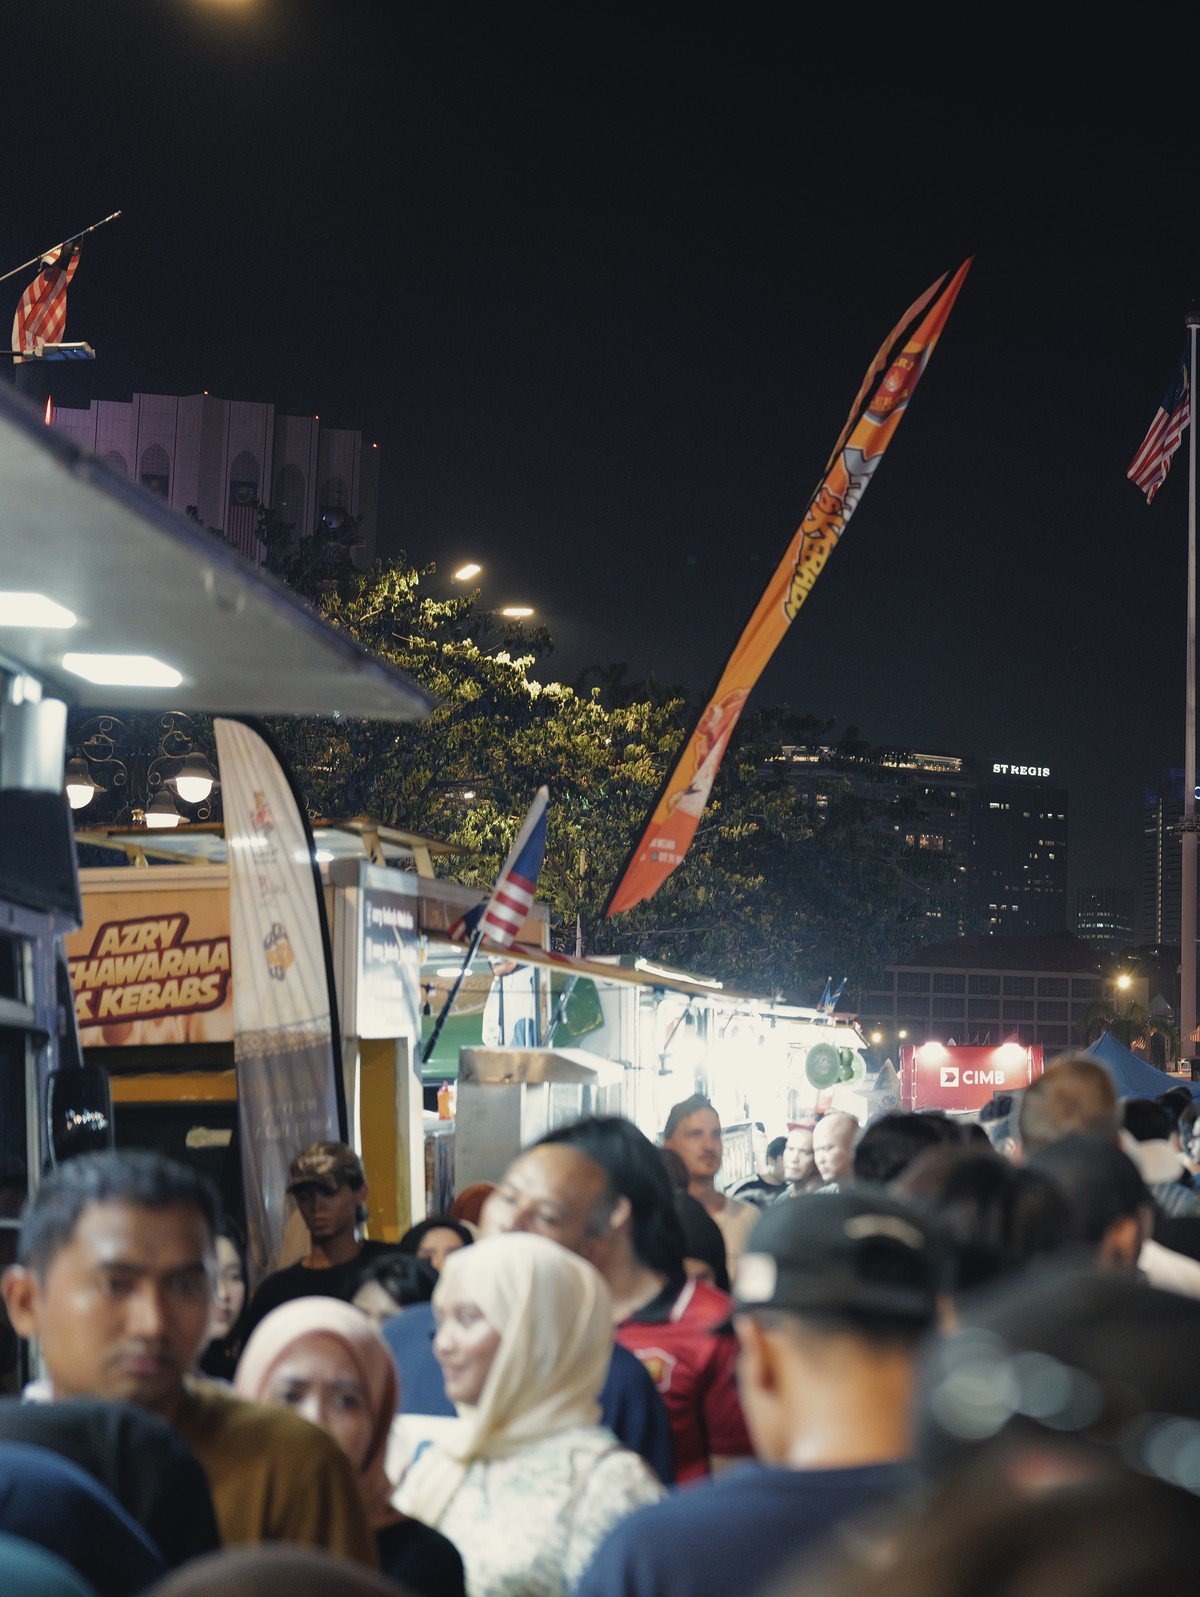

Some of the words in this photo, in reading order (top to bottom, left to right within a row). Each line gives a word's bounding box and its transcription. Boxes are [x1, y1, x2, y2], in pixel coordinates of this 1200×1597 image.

[992, 763, 1009, 775] ST
[1010, 765, 1050, 777] REGIS
[97, 918, 182, 957] AZRY
[98, 974, 221, 1018] KEBABS
[962, 1070, 1005, 1085] CIMB
